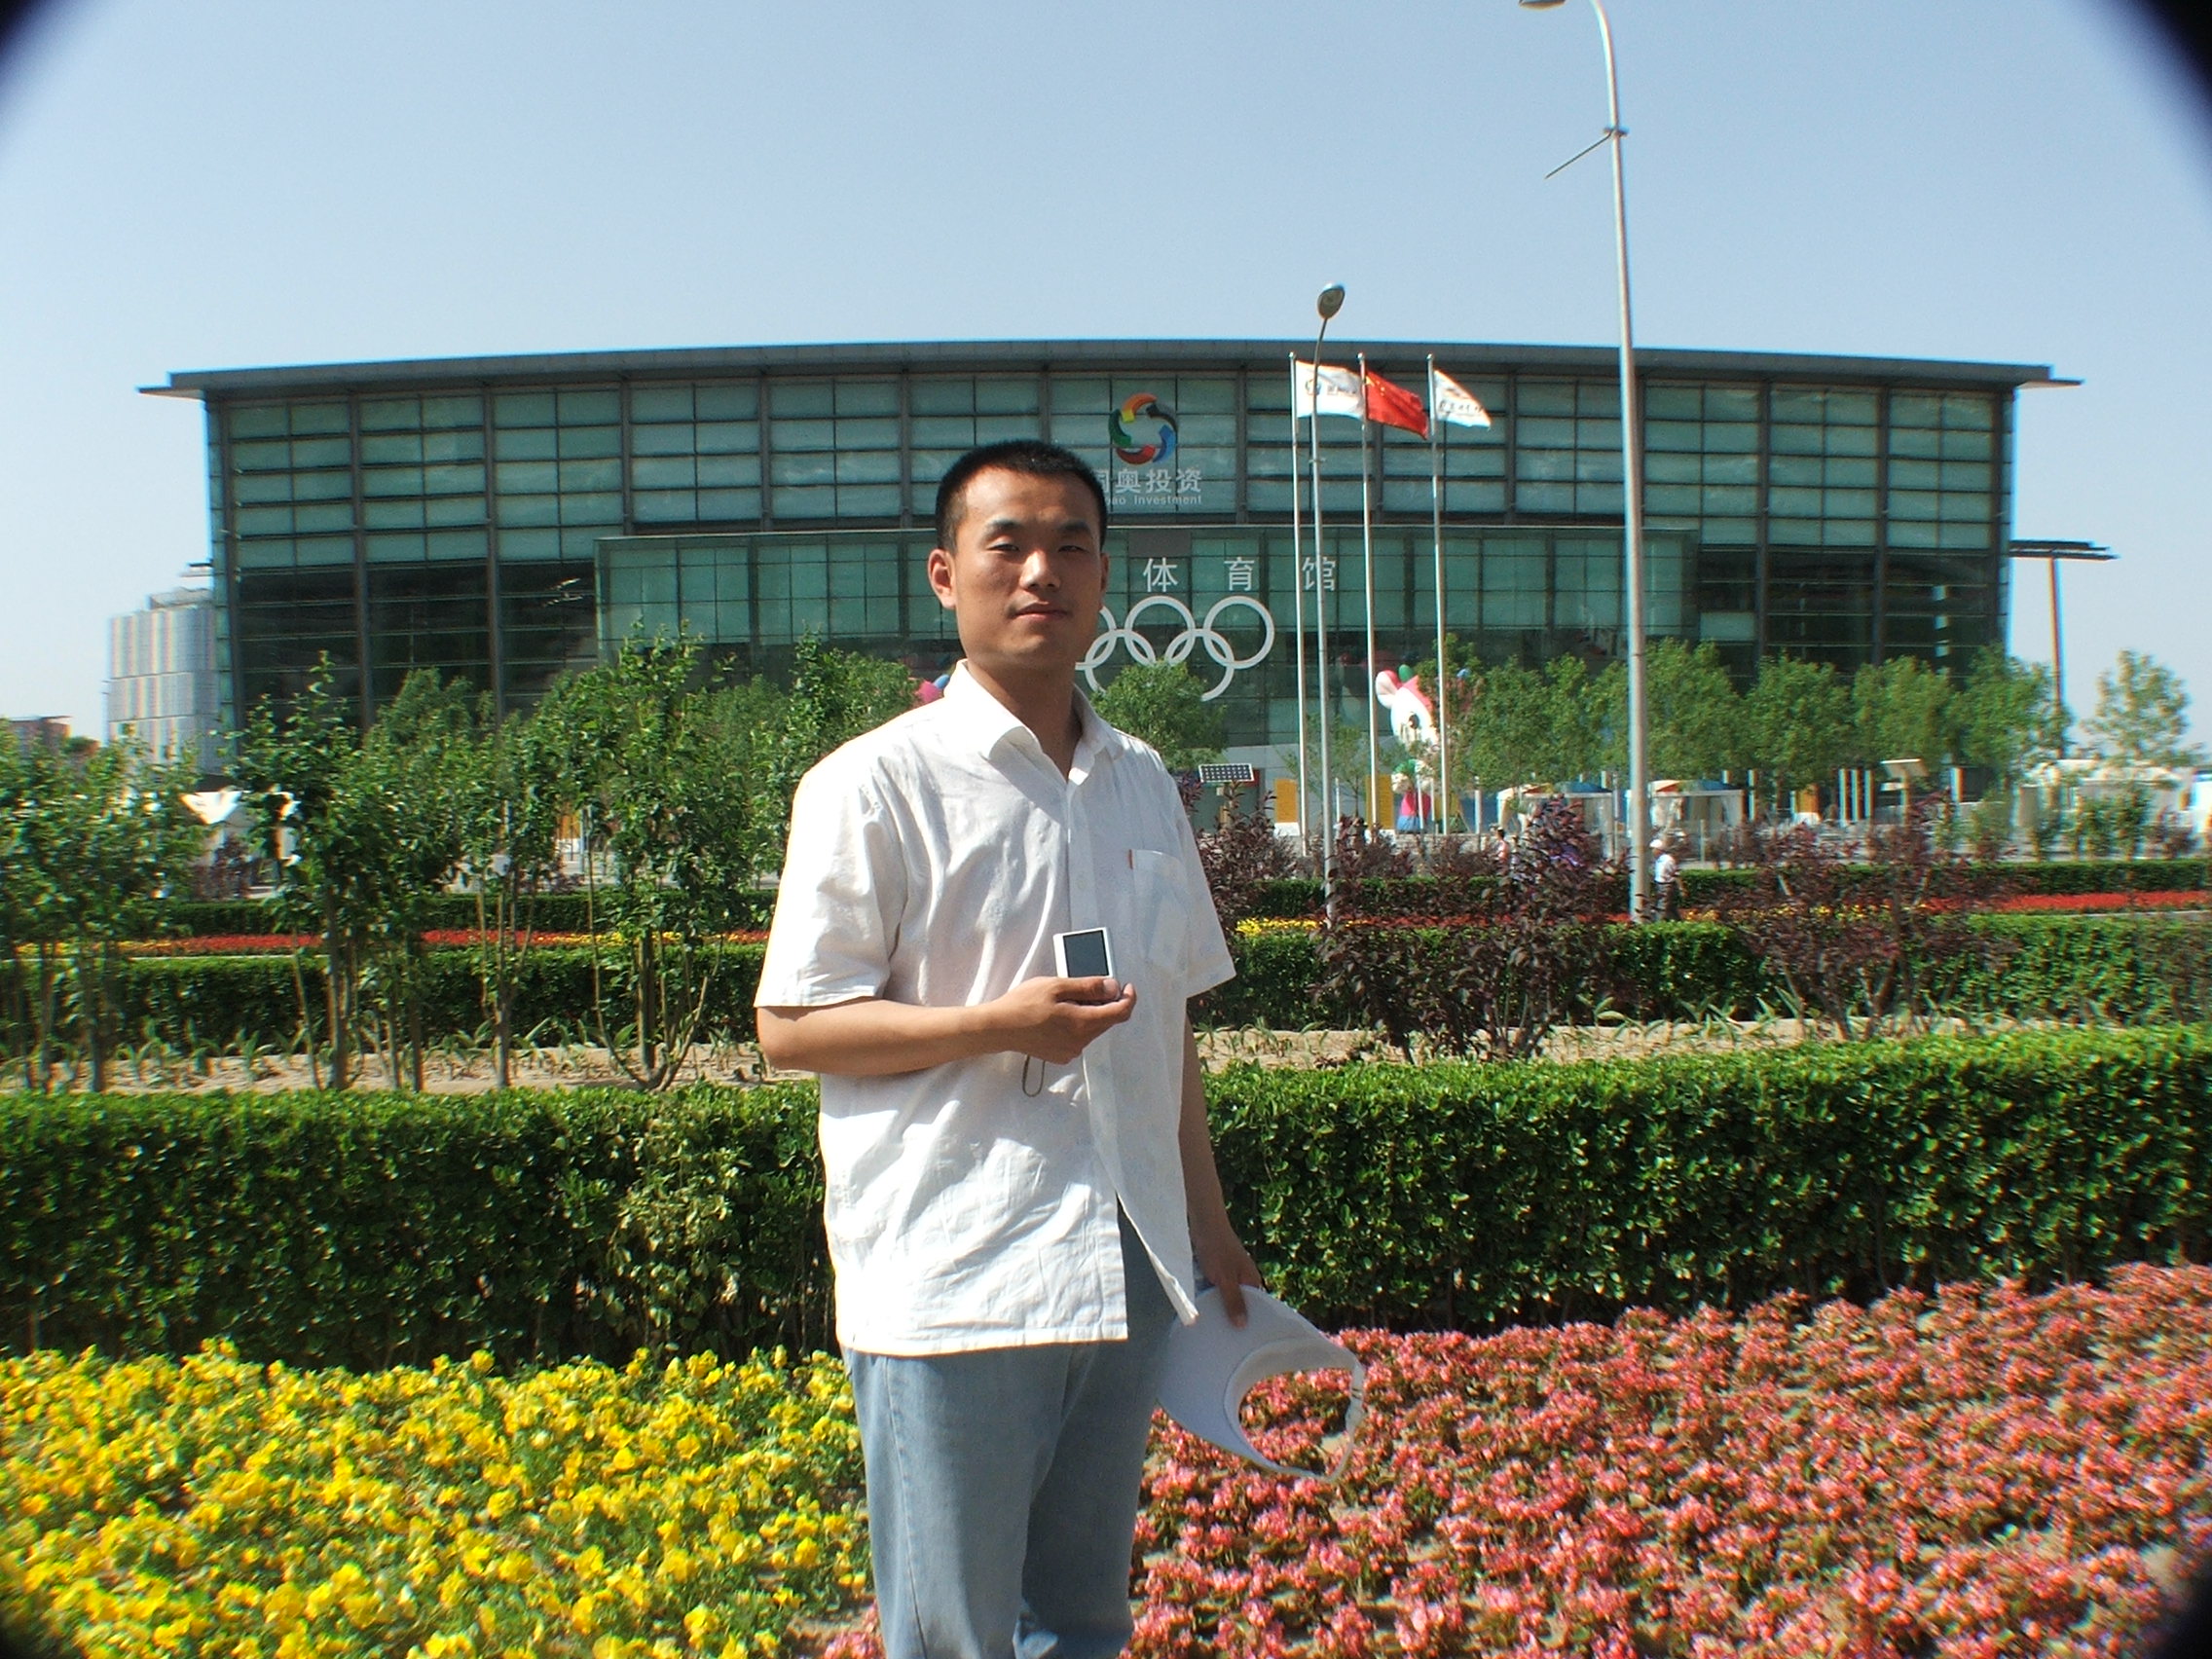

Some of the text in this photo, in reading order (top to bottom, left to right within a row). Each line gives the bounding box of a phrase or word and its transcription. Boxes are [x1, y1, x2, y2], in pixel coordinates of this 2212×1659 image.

[1133, 495, 1202, 505] Investment
[1142, 556, 1336, 592] 体育馆
